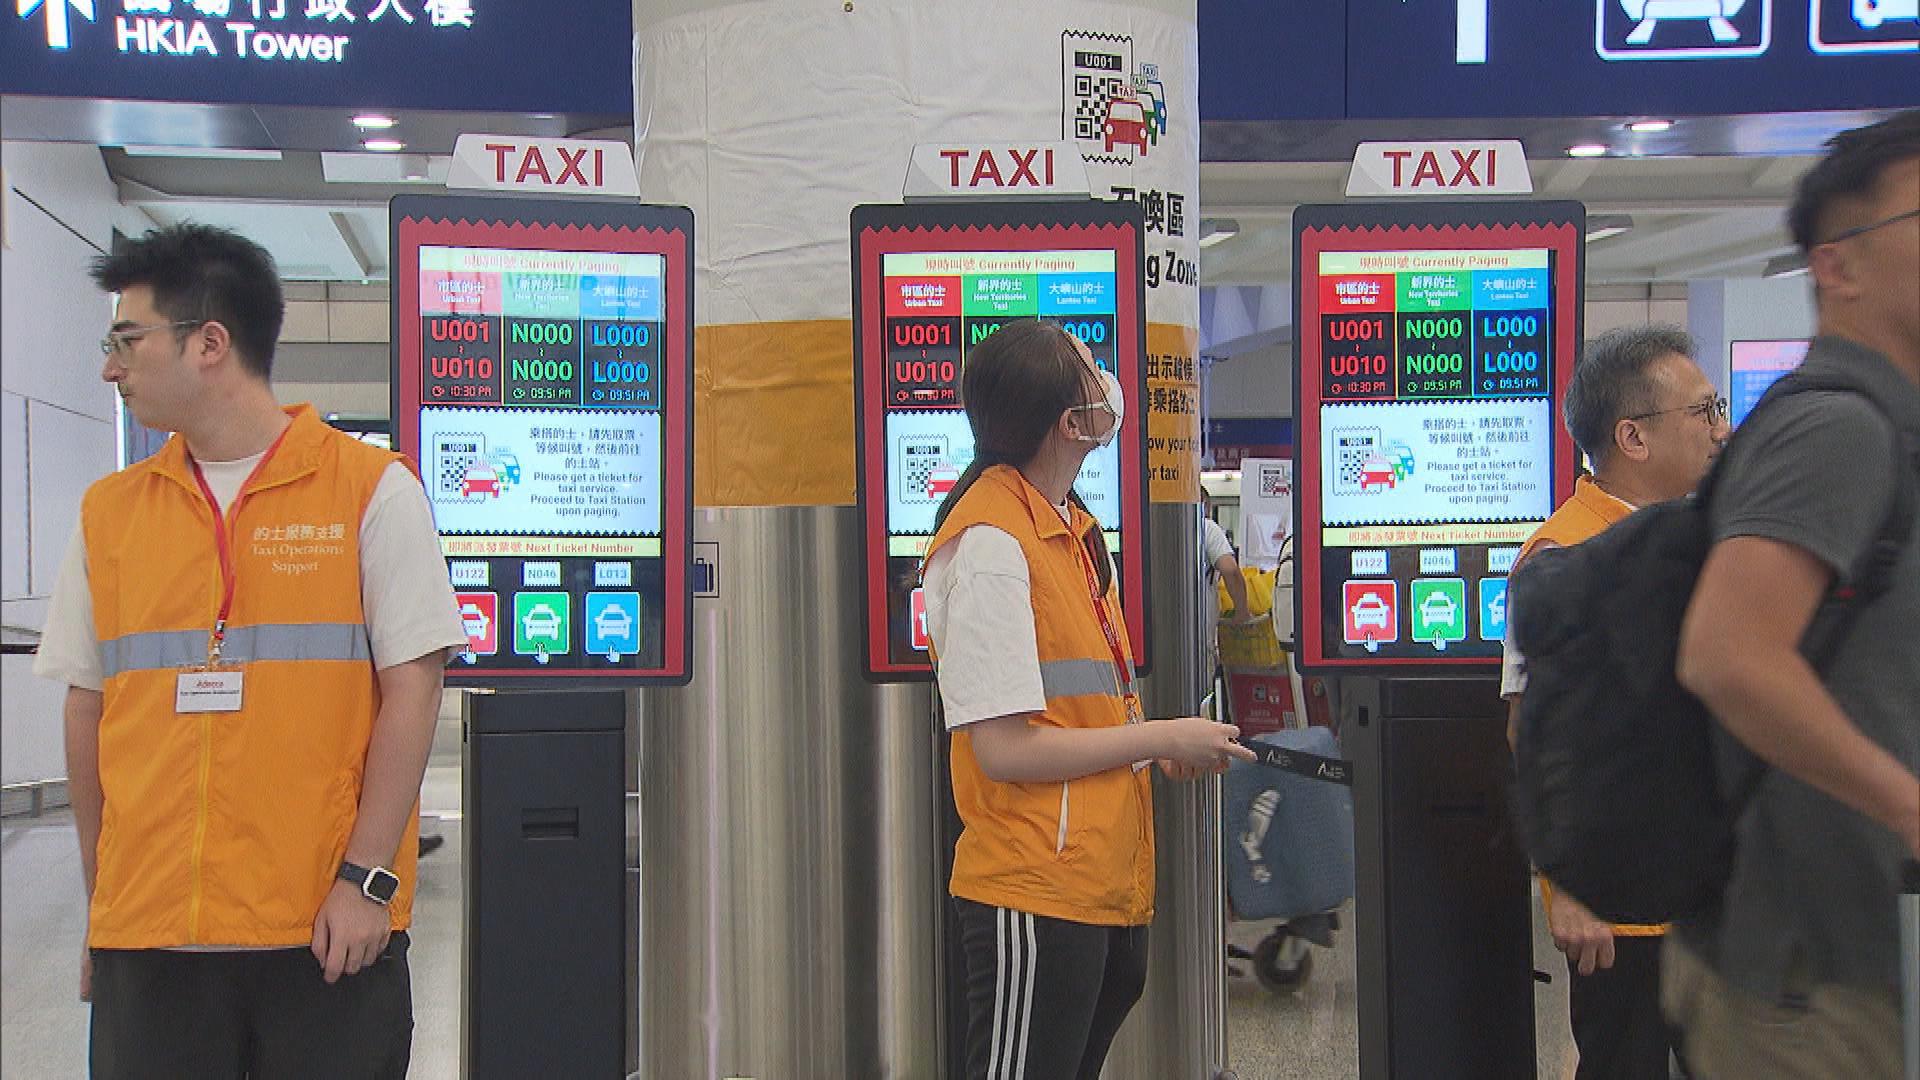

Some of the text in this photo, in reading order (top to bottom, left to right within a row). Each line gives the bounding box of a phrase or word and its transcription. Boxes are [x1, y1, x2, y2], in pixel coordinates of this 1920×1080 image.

[117, 16, 349, 62] HKIA Tower
[1085, 54, 1113, 68] U001
[486, 144, 603, 186] TAXI
[940, 150, 1053, 187] TAXI
[1384, 150, 1496, 187] TAXI
[520, 258, 574, 271] Currently
[580, 259, 620, 273] Paging
[979, 258, 1031, 270] Currently
[1035, 258, 1074, 270] Paging
[1413, 256, 1464, 267] Currently
[1469, 255, 1508, 267] Paging
[431, 320, 490, 342] U001
[1063, 321, 1105, 343] 000
[1330, 320, 1383, 340] U001
[1405, 318, 1463, 339] N000
[1485, 316, 1537, 337] L000
[512, 324, 573, 345] N000
[592, 325, 649, 347] L000
[895, 324, 950, 345] U001
[431, 357, 493, 379] U010
[1330, 354, 1386, 376] U010
[1405, 354, 1463, 375] N000
[1485, 352, 1537, 373] L000
[512, 360, 573, 381] N000
[592, 362, 649, 382] L000
[895, 361, 954, 383] U010
[1347, 382, 1371, 392] 10:30
[1160, 464, 1179, 480] taxi
[1427, 461, 1460, 470] Please
[1463, 462, 1477, 472] get
[1489, 461, 1516, 469] ticket
[1519, 460, 1532, 469] for
[534, 472, 567, 481] Please
[571, 473, 586, 482] get
[599, 472, 626, 481] ticket
[629, 472, 642, 481] for
[1088, 470, 1100, 478] for
[1451, 472, 1508, 480] taxi service.
[559, 484, 618, 493] taxi service.
[1425, 482, 1535, 492] Proceed to Taxi Station
[531, 494, 645, 504] Proceed to Taxi Station
[1083, 492, 1104, 500] tion
[1449, 495, 1511, 504] upon paging.
[556, 507, 620, 517] upon paging.
[1421, 532, 1445, 542] Next
[1450, 531, 1480, 540] Ticket
[1484, 530, 1524, 539] Number
[251, 543, 344, 557] Taxi Operations
[526, 542, 550, 553] Next
[556, 542, 587, 553] Ticket
[591, 542, 634, 553] Number
[1356, 559, 1382, 568] U122
[1423, 557, 1450, 566] N046
[1491, 556, 1511, 565] L01
[272, 561, 318, 575] Support
[456, 569, 485, 578] U122
[528, 569, 556, 578] N046
[600, 570, 626, 578] L013
